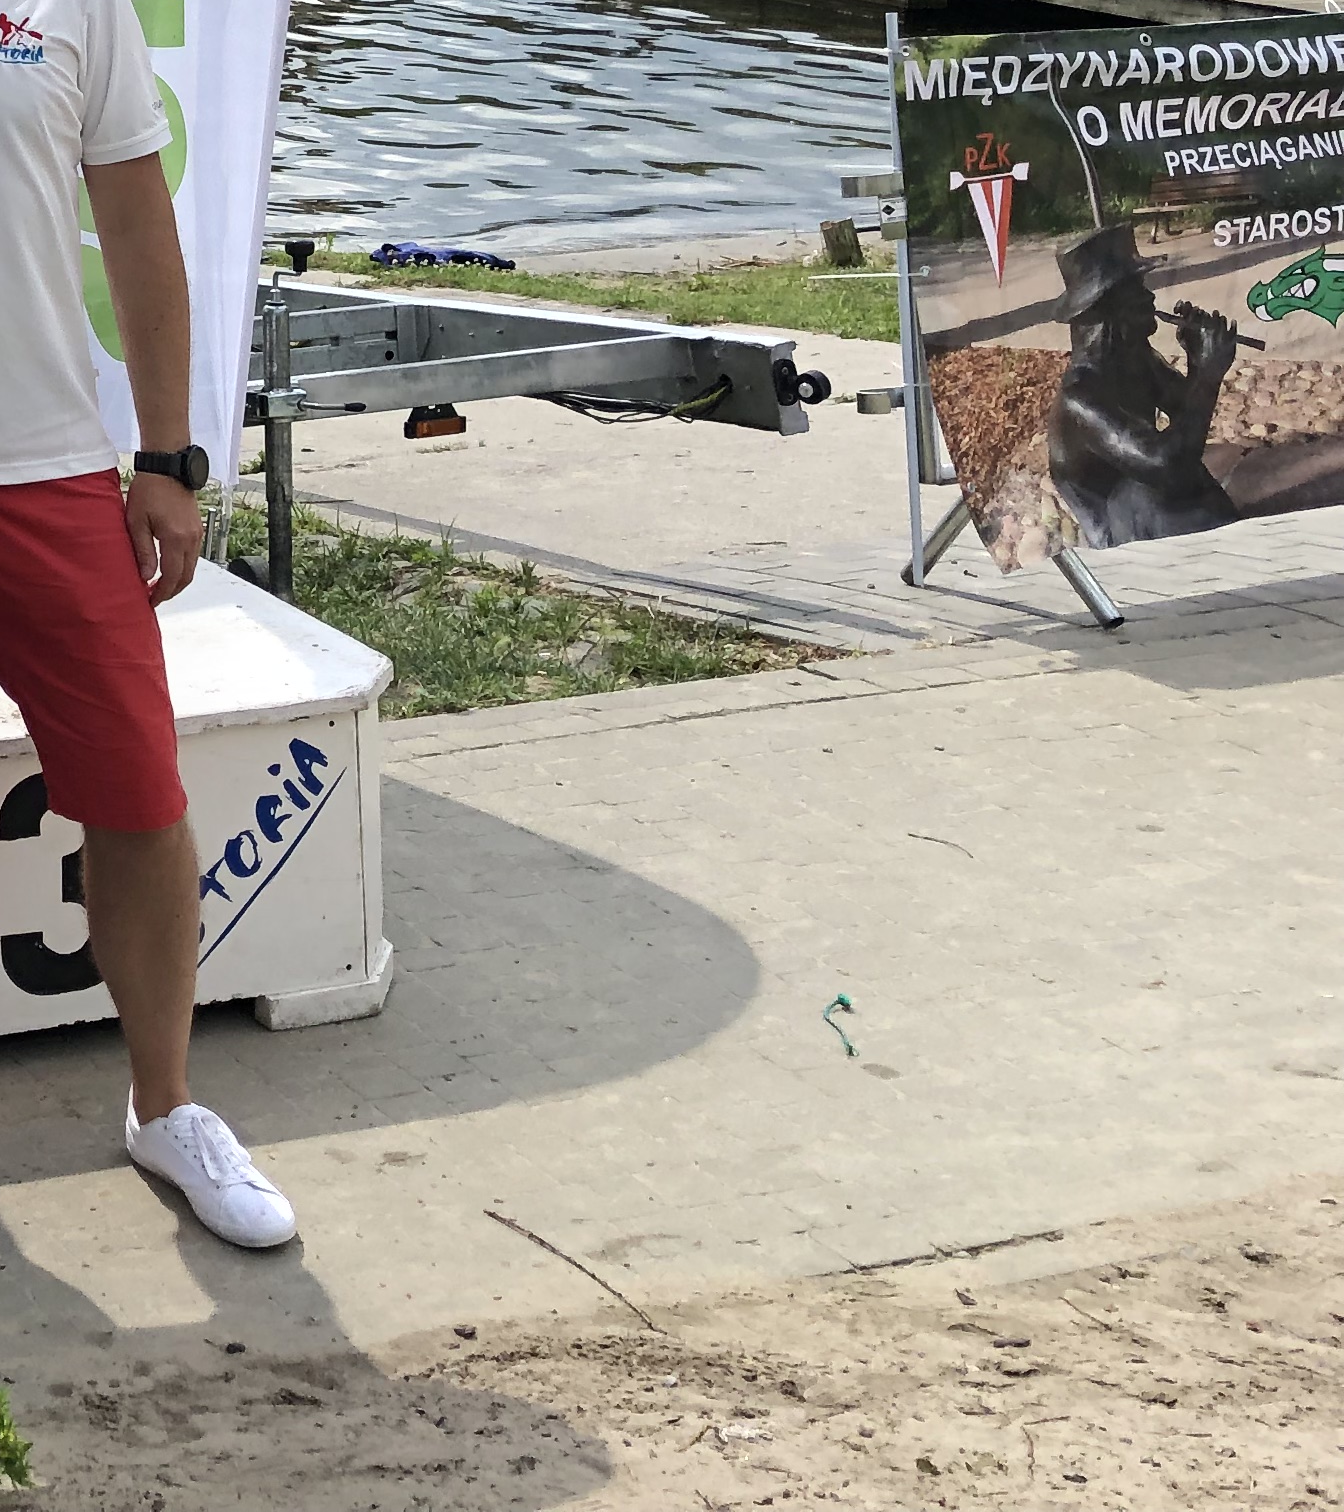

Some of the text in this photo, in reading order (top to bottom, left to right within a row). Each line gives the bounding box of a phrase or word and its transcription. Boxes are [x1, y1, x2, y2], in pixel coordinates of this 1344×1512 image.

[1076, 106, 1108, 146] O
[965, 133, 1010, 171] PZK
[1165, 131, 1344, 177] PRZECIĄGANI
